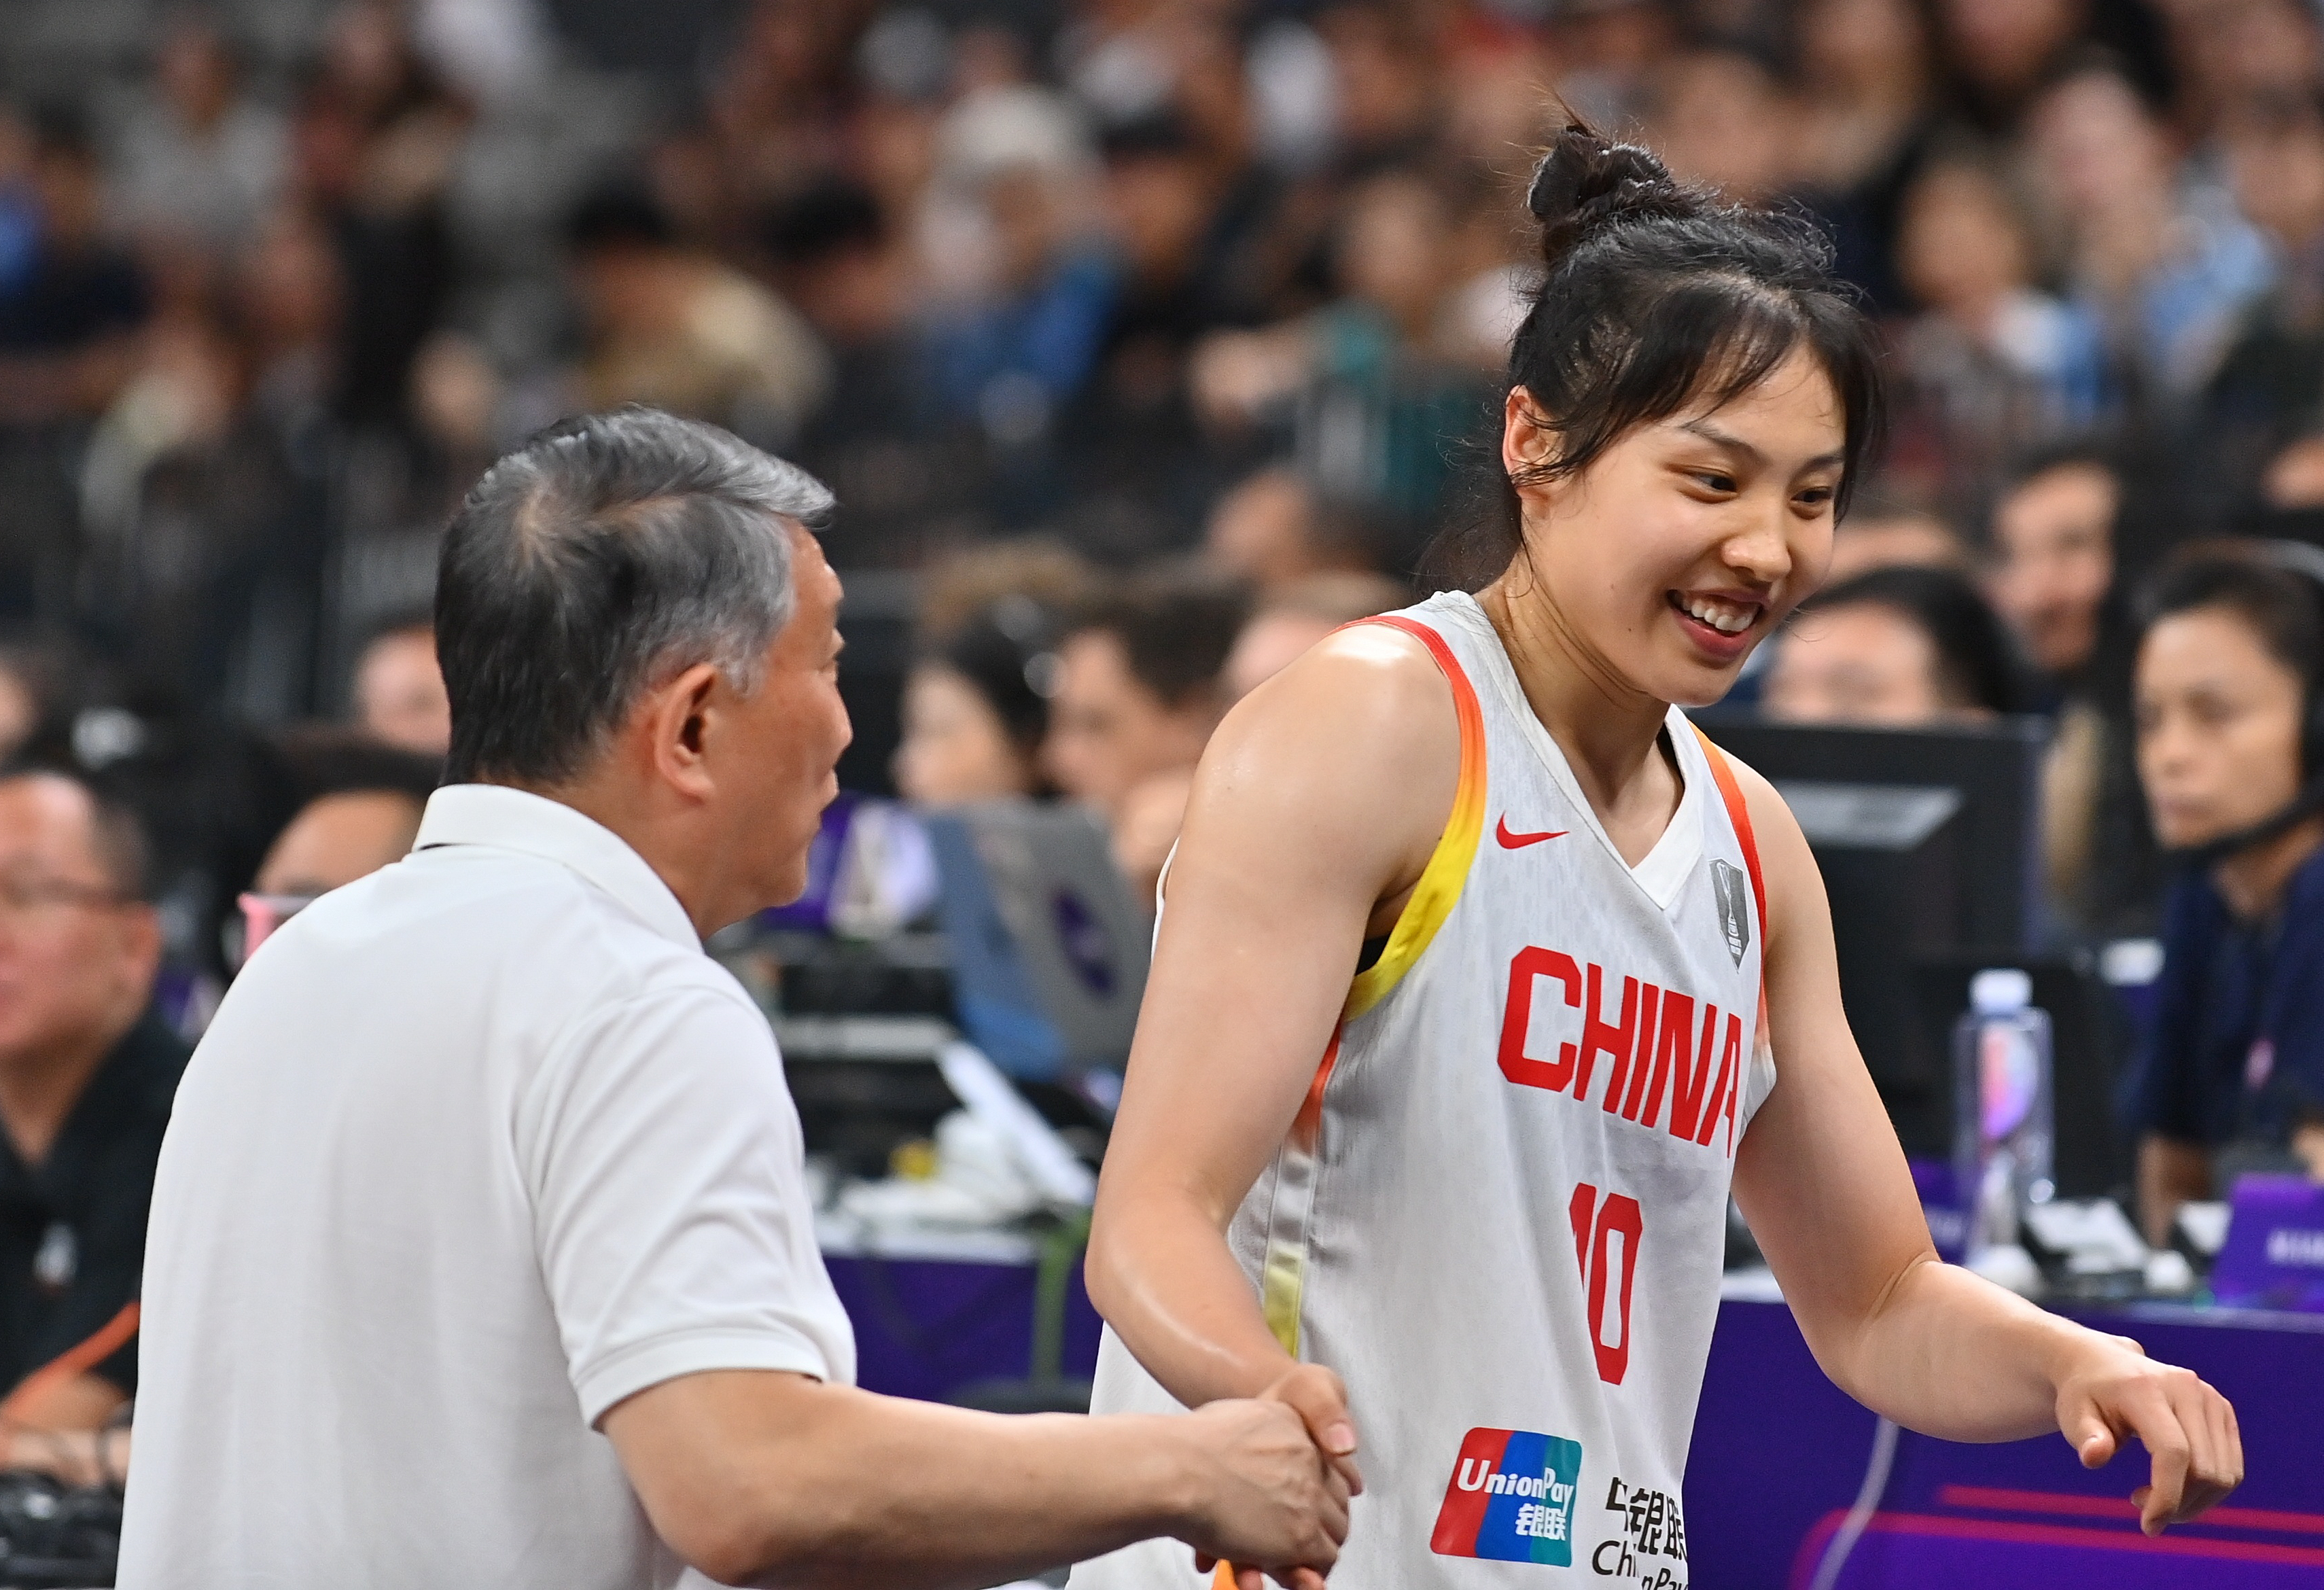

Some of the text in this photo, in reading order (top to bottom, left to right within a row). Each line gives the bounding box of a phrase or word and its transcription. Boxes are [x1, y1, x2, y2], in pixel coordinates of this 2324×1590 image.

[1497, 945, 1741, 1159] CHINA
[1457, 1458, 1574, 1517] UnionPay
[1515, 1503, 1566, 1541] 银联
